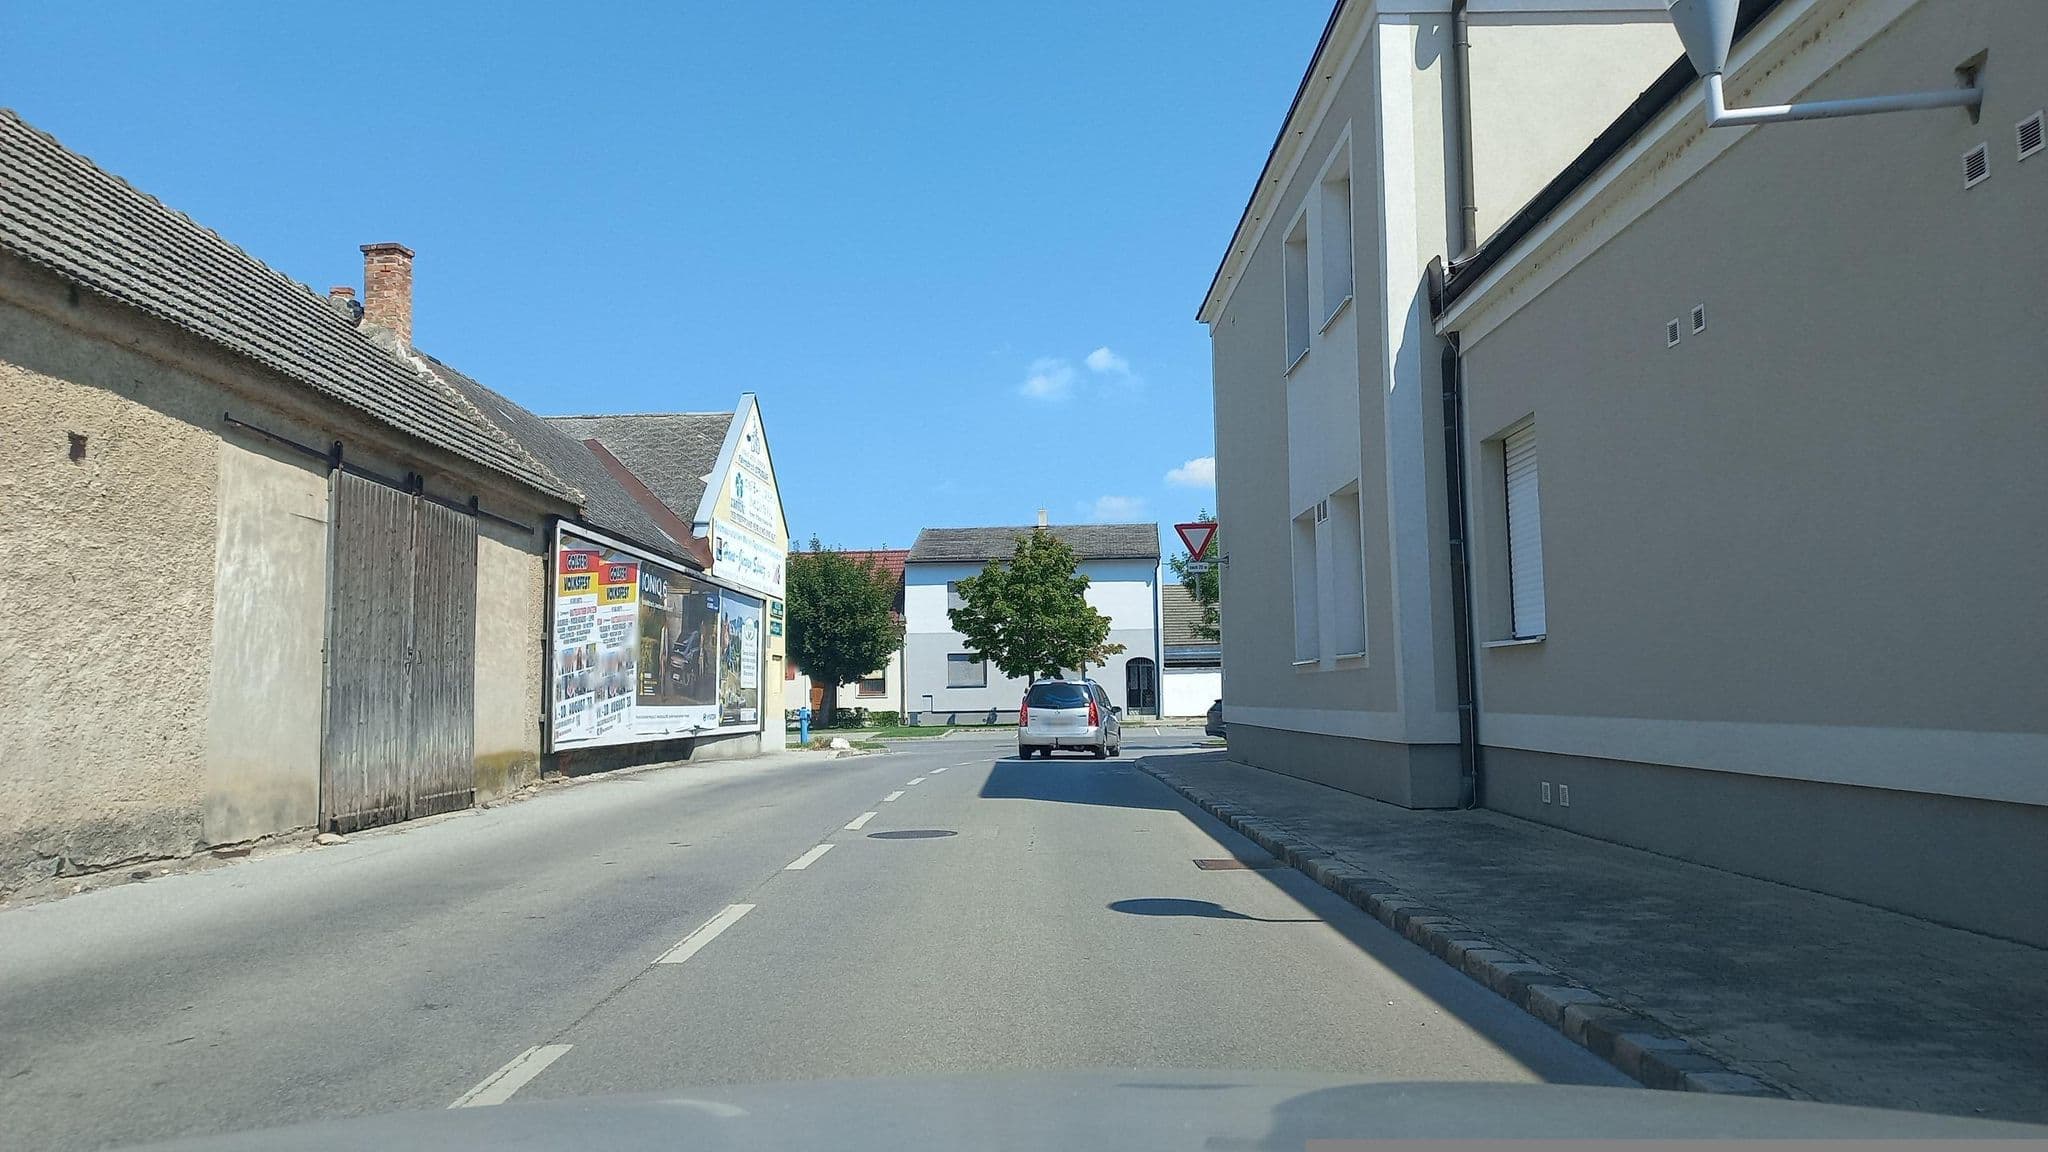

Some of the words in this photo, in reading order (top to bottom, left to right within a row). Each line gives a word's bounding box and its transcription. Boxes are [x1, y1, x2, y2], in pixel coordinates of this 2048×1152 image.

[567, 554, 587, 570] GOLSER
[609, 566, 627, 581] GOLSER
[563, 575, 591, 591] VOLKSFEST
[642, 572, 662, 599] IONIQ
[662, 580, 668, 598] 6
[606, 586, 630, 601] VOLKSFEST
